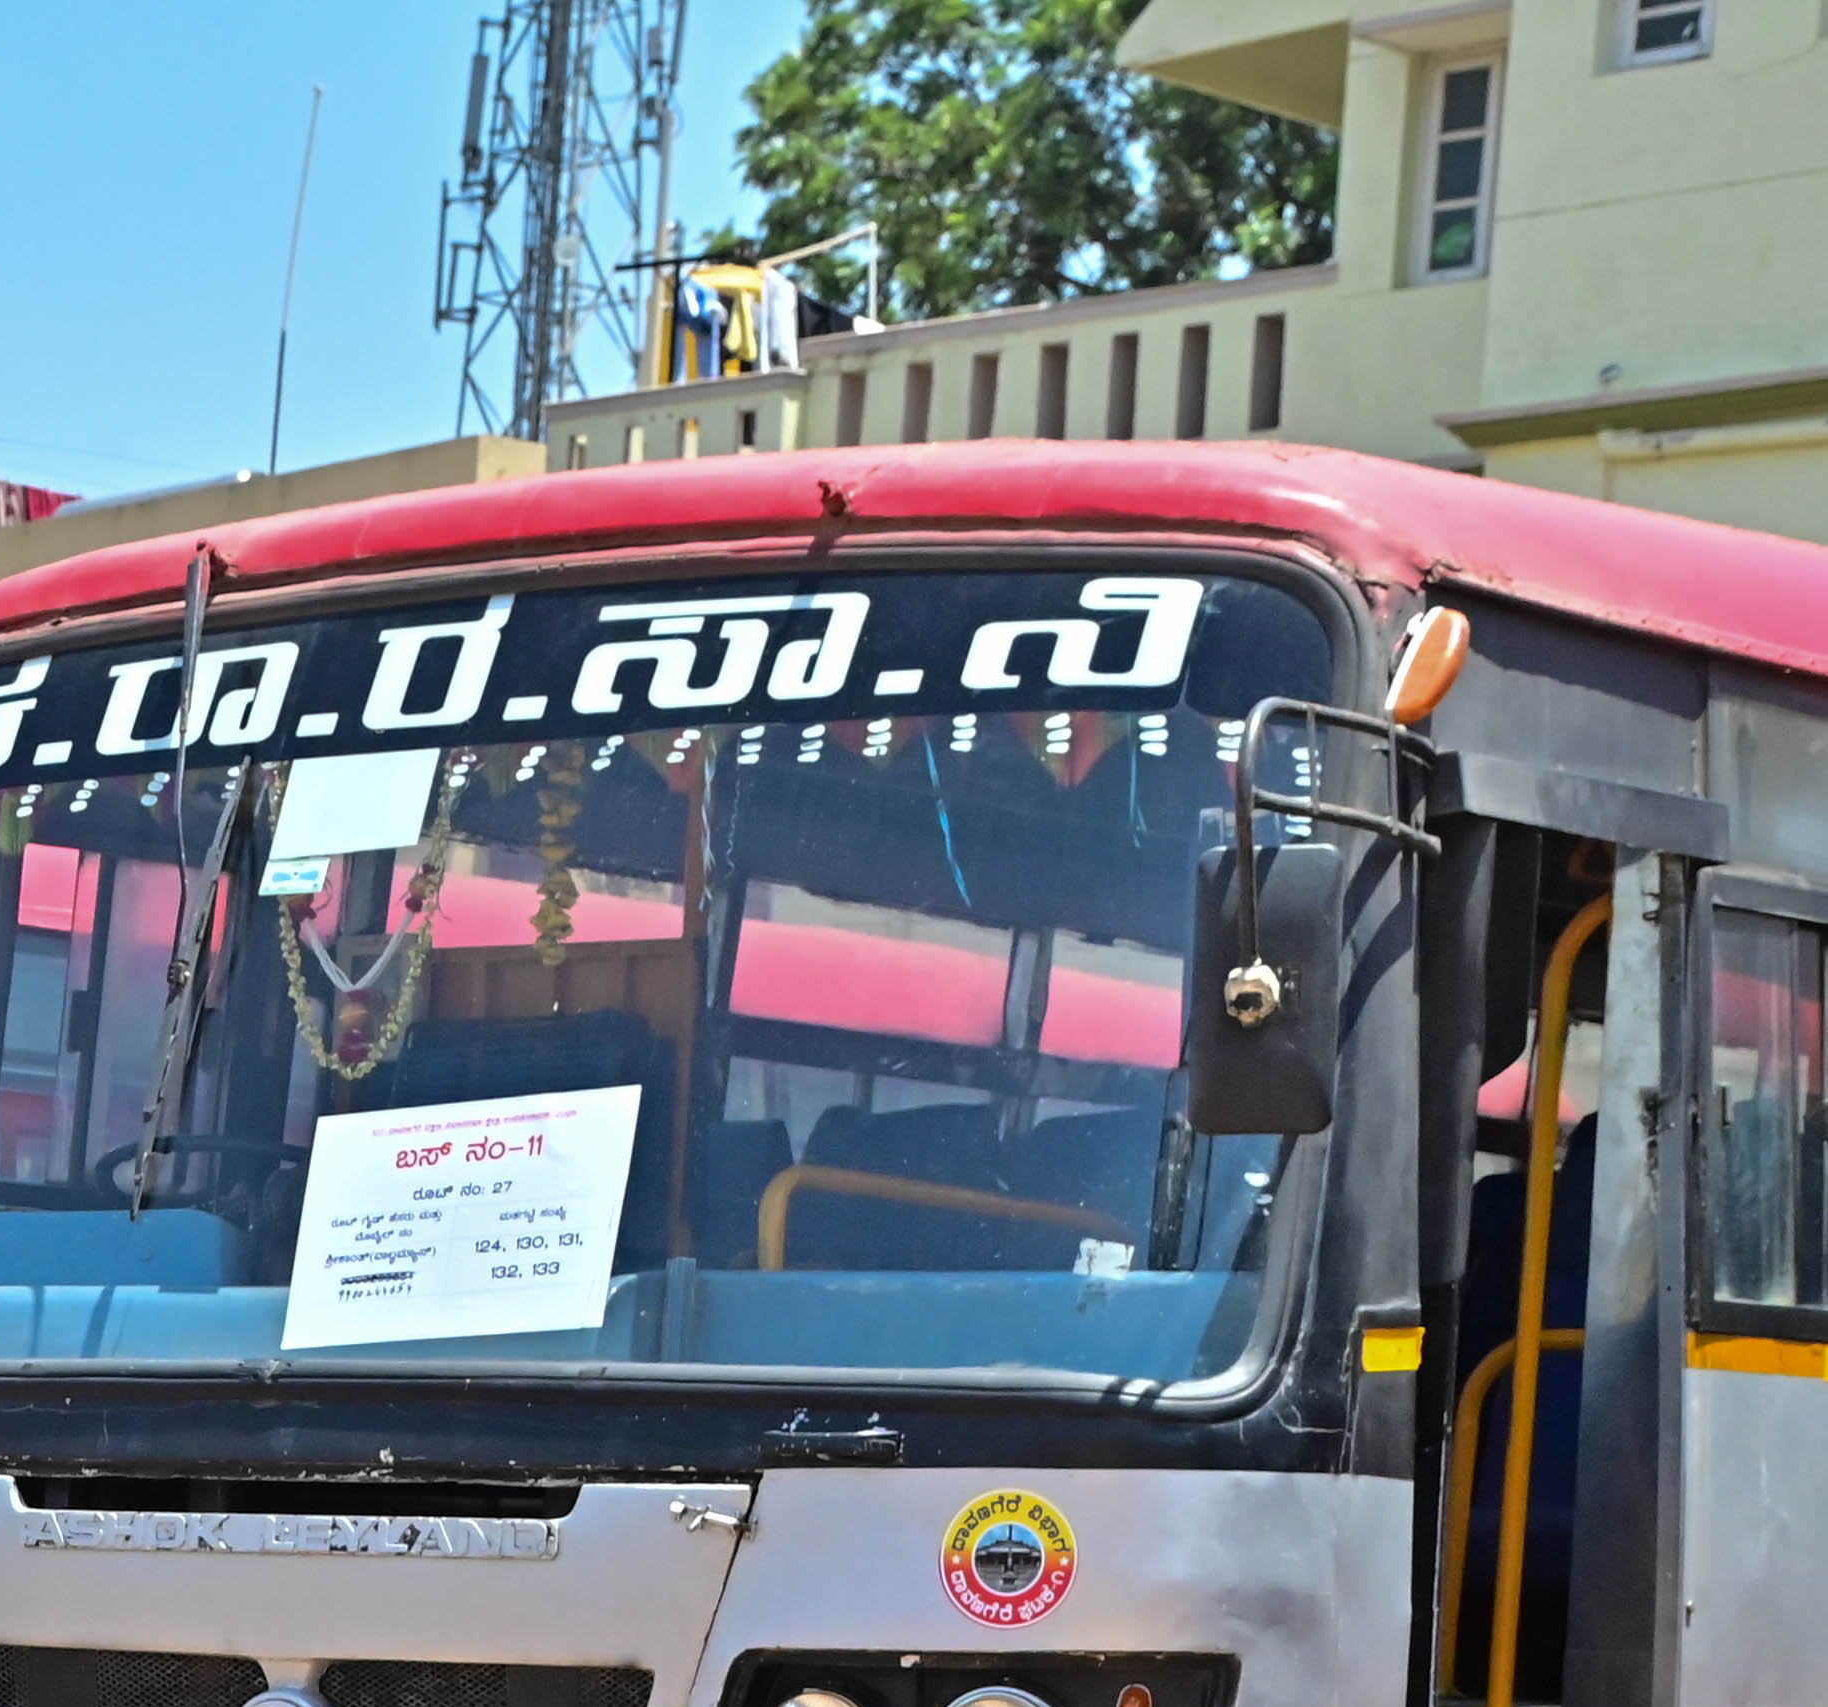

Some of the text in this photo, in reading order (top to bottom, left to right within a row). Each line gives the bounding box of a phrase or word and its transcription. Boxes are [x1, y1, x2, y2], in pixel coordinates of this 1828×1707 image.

[396, 1134, 544, 1168] ಬಸ್ ನಂ-11
[412, 1184, 454, 1201] ರೂಟ್
[492, 1180, 512, 1194] 27
[475, 1239, 506, 1253] 124,
[515, 1235, 549, 1251] 130,
[491, 1261, 560, 1279] 132, 133
[24, 1512, 559, 1560] ASHOK LEYLAND
